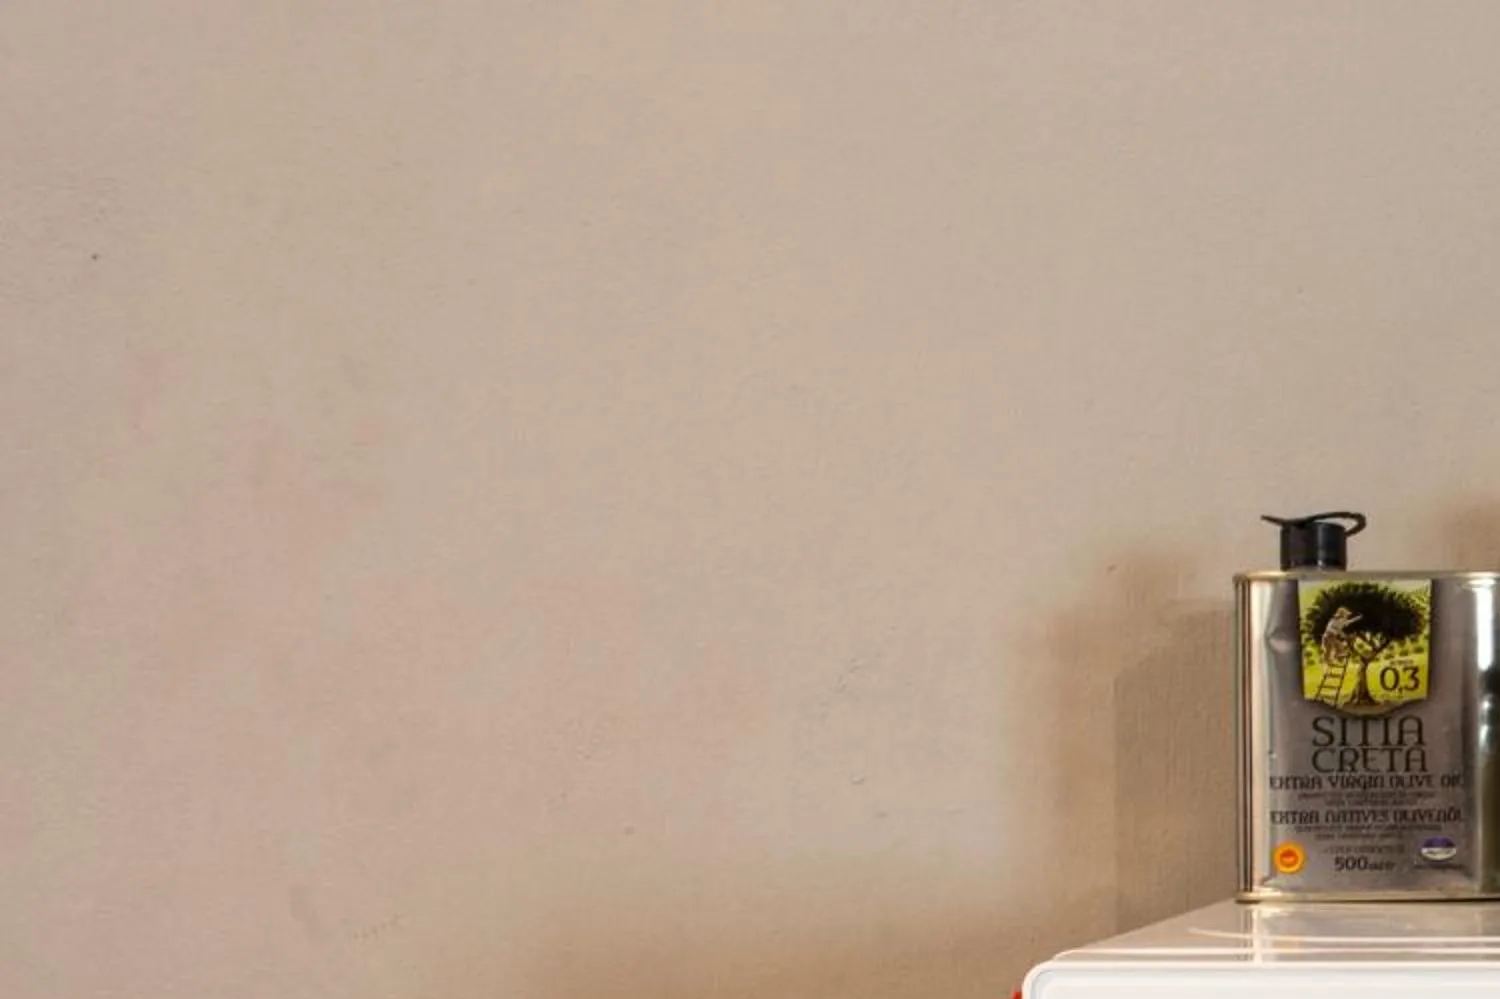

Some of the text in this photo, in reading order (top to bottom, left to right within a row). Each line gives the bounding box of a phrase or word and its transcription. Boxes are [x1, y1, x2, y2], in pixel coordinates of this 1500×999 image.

[1312, 715, 1426, 747] SITIA
[1312, 747, 1428, 773] CRETA
[1327, 776, 1384, 791] VIRGIN
[1390, 775, 1433, 789] OLIVE
